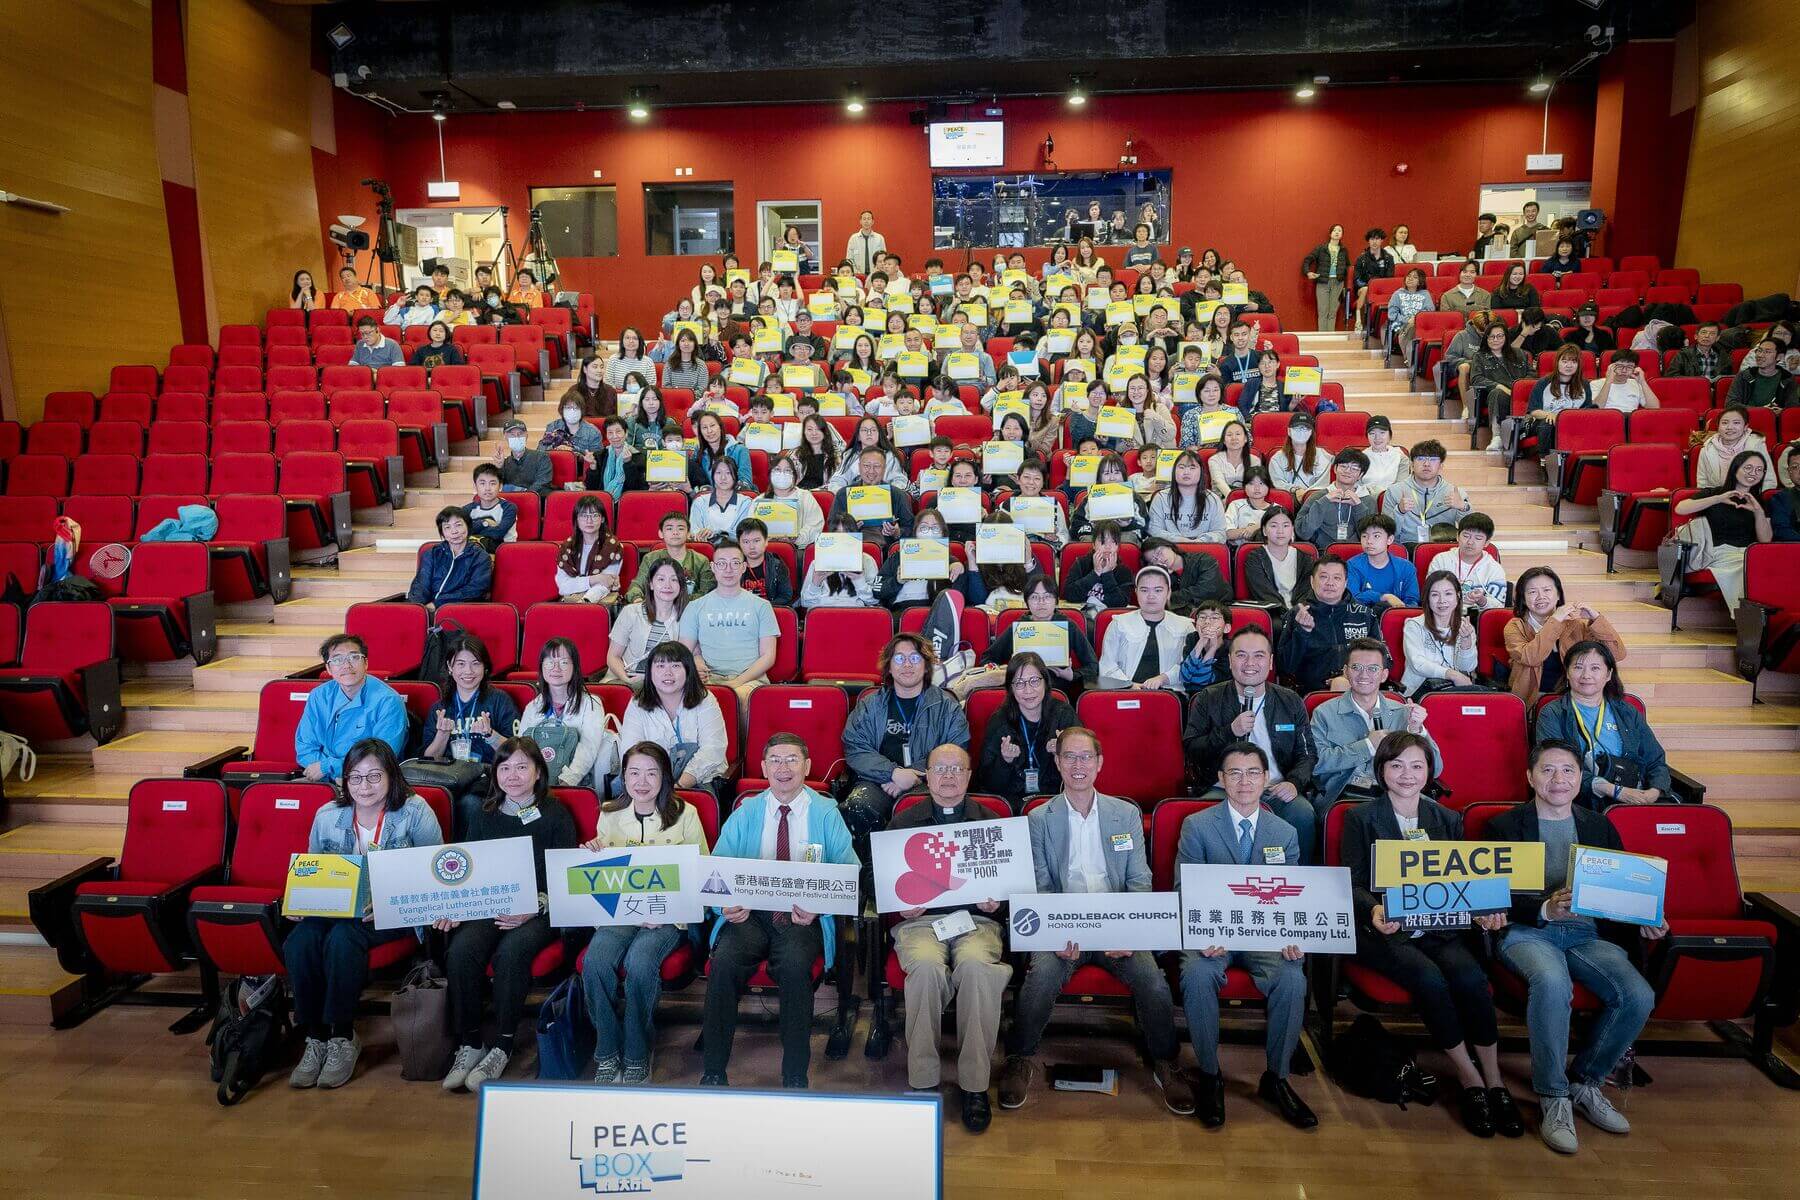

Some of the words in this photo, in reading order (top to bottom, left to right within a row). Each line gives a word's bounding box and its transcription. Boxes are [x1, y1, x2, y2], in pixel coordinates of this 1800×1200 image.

[1344, 626, 1368, 634] MOVE
[1400, 847, 1513, 878] PEACE
[1587, 857, 1613, 866] PEACE
[584, 868, 666, 891] YWCA
[974, 865, 998, 879] POOR
[734, 874, 857, 893] 香港福音盛會有限公司
[389, 882, 521, 905] 基督教香港信義會社會服務部
[734, 887, 753, 896] Hong
[755, 888, 774, 897] Kong
[775, 890, 801, 899] Gospel
[803, 891, 828, 899] Festival
[830, 893, 857, 901] Limited
[1402, 881, 1472, 911] BOX
[398, 903, 444, 915] Evangelical
[445, 899, 483, 910] Lutheran
[484, 896, 514, 905] Church
[623, 894, 667, 916] 女青
[403, 914, 428, 924] Social
[466, 908, 488, 919] Hong
[490, 906, 511, 917] Kong
[1048, 912, 1125, 920] SADDLEBACK
[1128, 912, 1177, 920] CHURCH
[1188, 909, 1350, 927] 康業服務有限公司
[1405, 911, 1472, 927] 祝福大行動
[1188, 926, 1215, 938] Hong
[1217, 926, 1235, 938] Yip
[1237, 927, 1277, 938] Service
[1280, 928, 1327, 941] Company
[1330, 929, 1351, 939] Ltd.
[594, 1122, 687, 1148] PEACE
[595, 1152, 653, 1177] BOX
